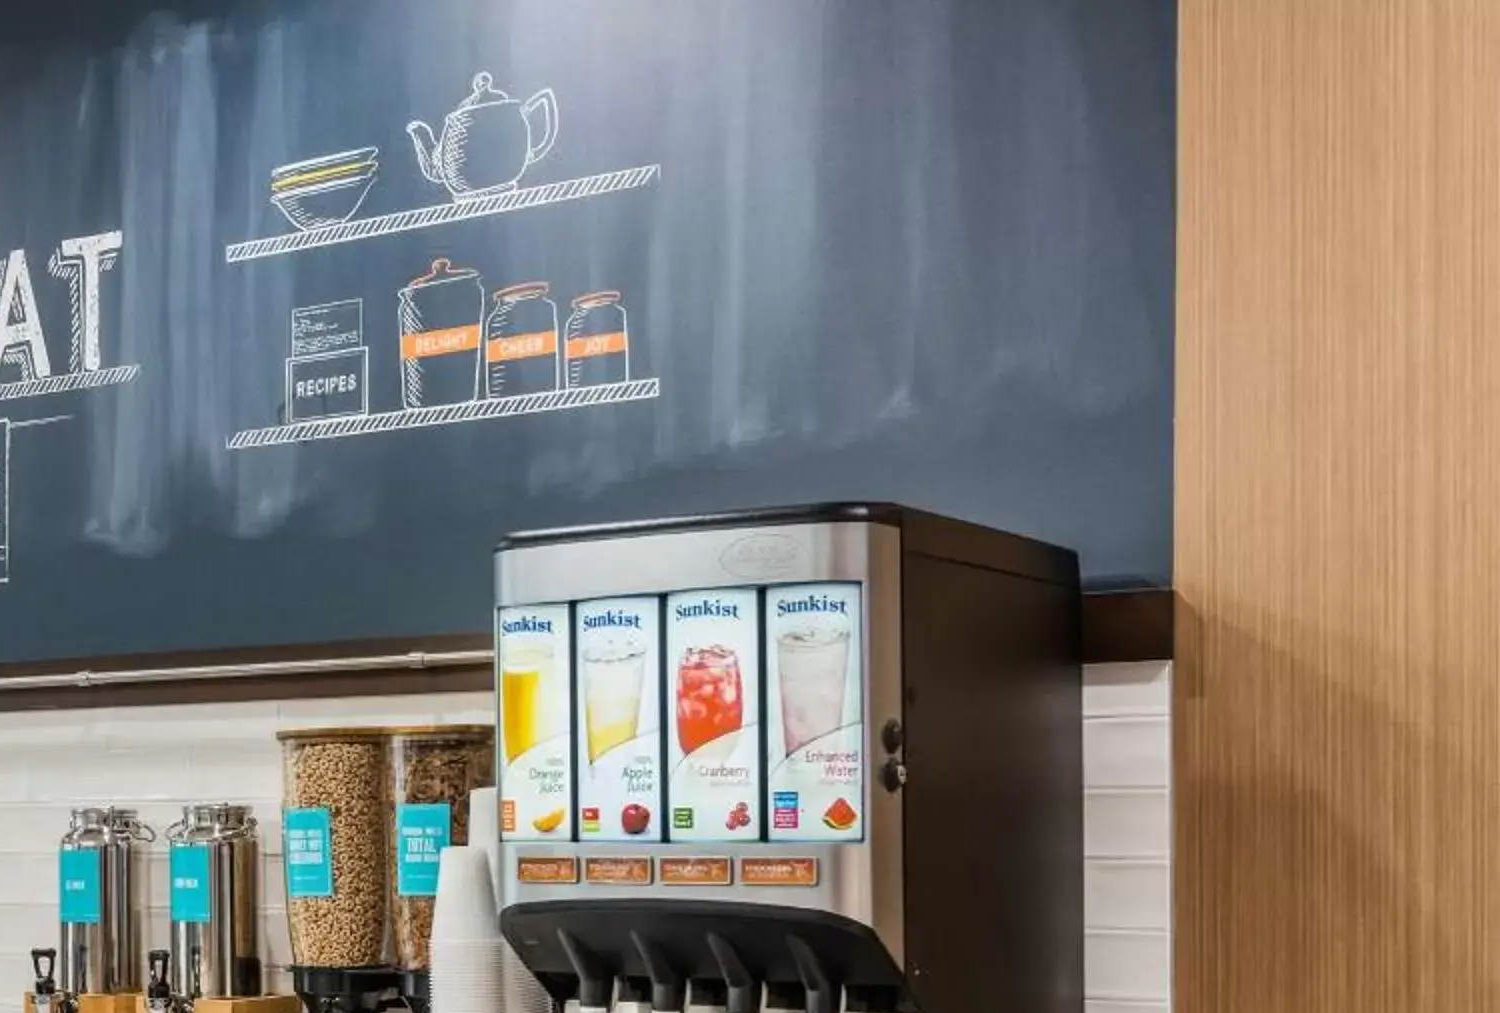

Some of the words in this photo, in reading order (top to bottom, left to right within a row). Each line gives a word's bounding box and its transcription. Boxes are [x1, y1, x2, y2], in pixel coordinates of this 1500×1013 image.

[416, 332, 468, 349] DELIGHT
[502, 337, 544, 354] CHEER
[586, 336, 610, 351] JOY
[295, 373, 357, 399] RECIPES
[676, 599, 740, 622] Sunkist
[777, 595, 848, 618] Sunkist
[502, 616, 553, 633] Sunkist
[583, 610, 642, 632] Sunkist
[805, 751, 859, 763] Enhanced
[529, 767, 565, 783] Orange
[621, 764, 653, 782] Apple
[698, 765, 750, 780] Cranberry
[823, 765, 858, 778] Water
[540, 782, 564, 794] Juice
[627, 780, 652, 794] Juice
[406, 837, 437, 853] TOTAL
